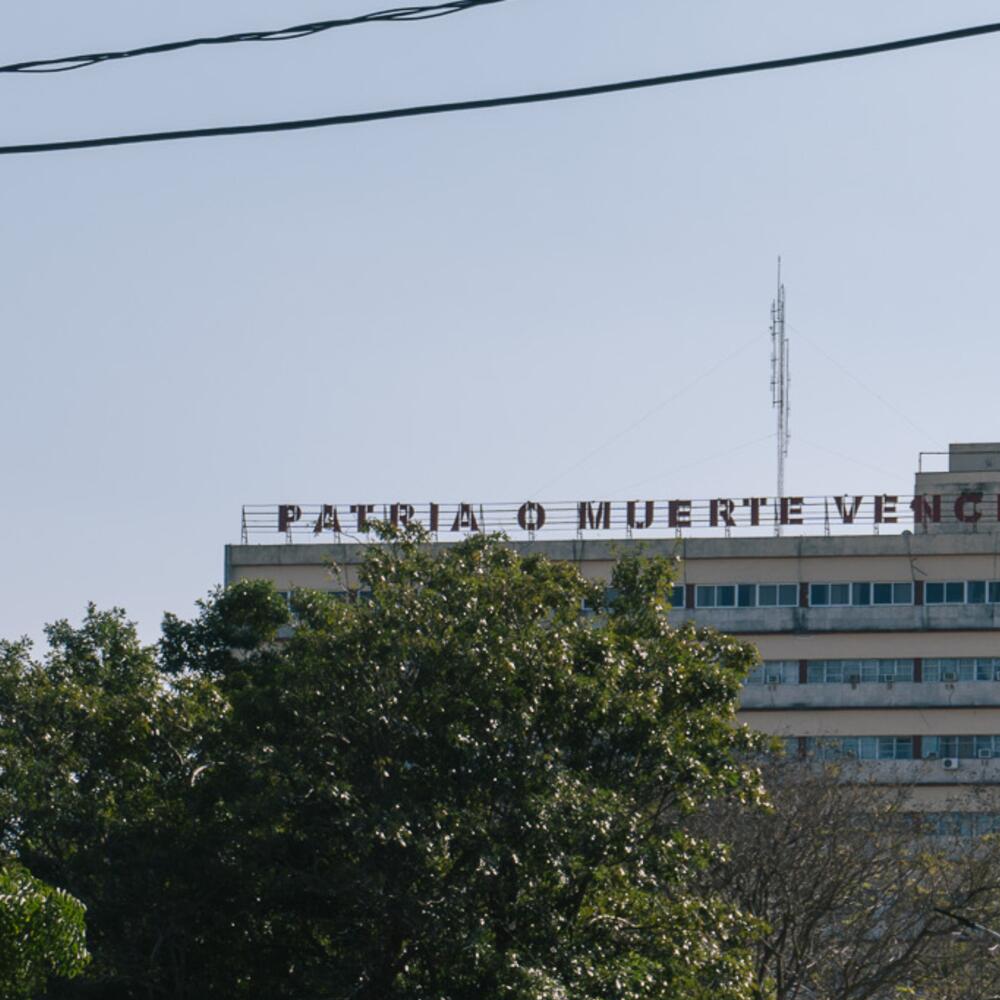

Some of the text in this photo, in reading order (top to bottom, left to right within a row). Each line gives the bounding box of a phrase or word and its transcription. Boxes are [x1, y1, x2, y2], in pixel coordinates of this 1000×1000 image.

[278, 503, 479, 532] PATRIA
[517, 501, 546, 530] O
[578, 497, 804, 529] MUERTE
